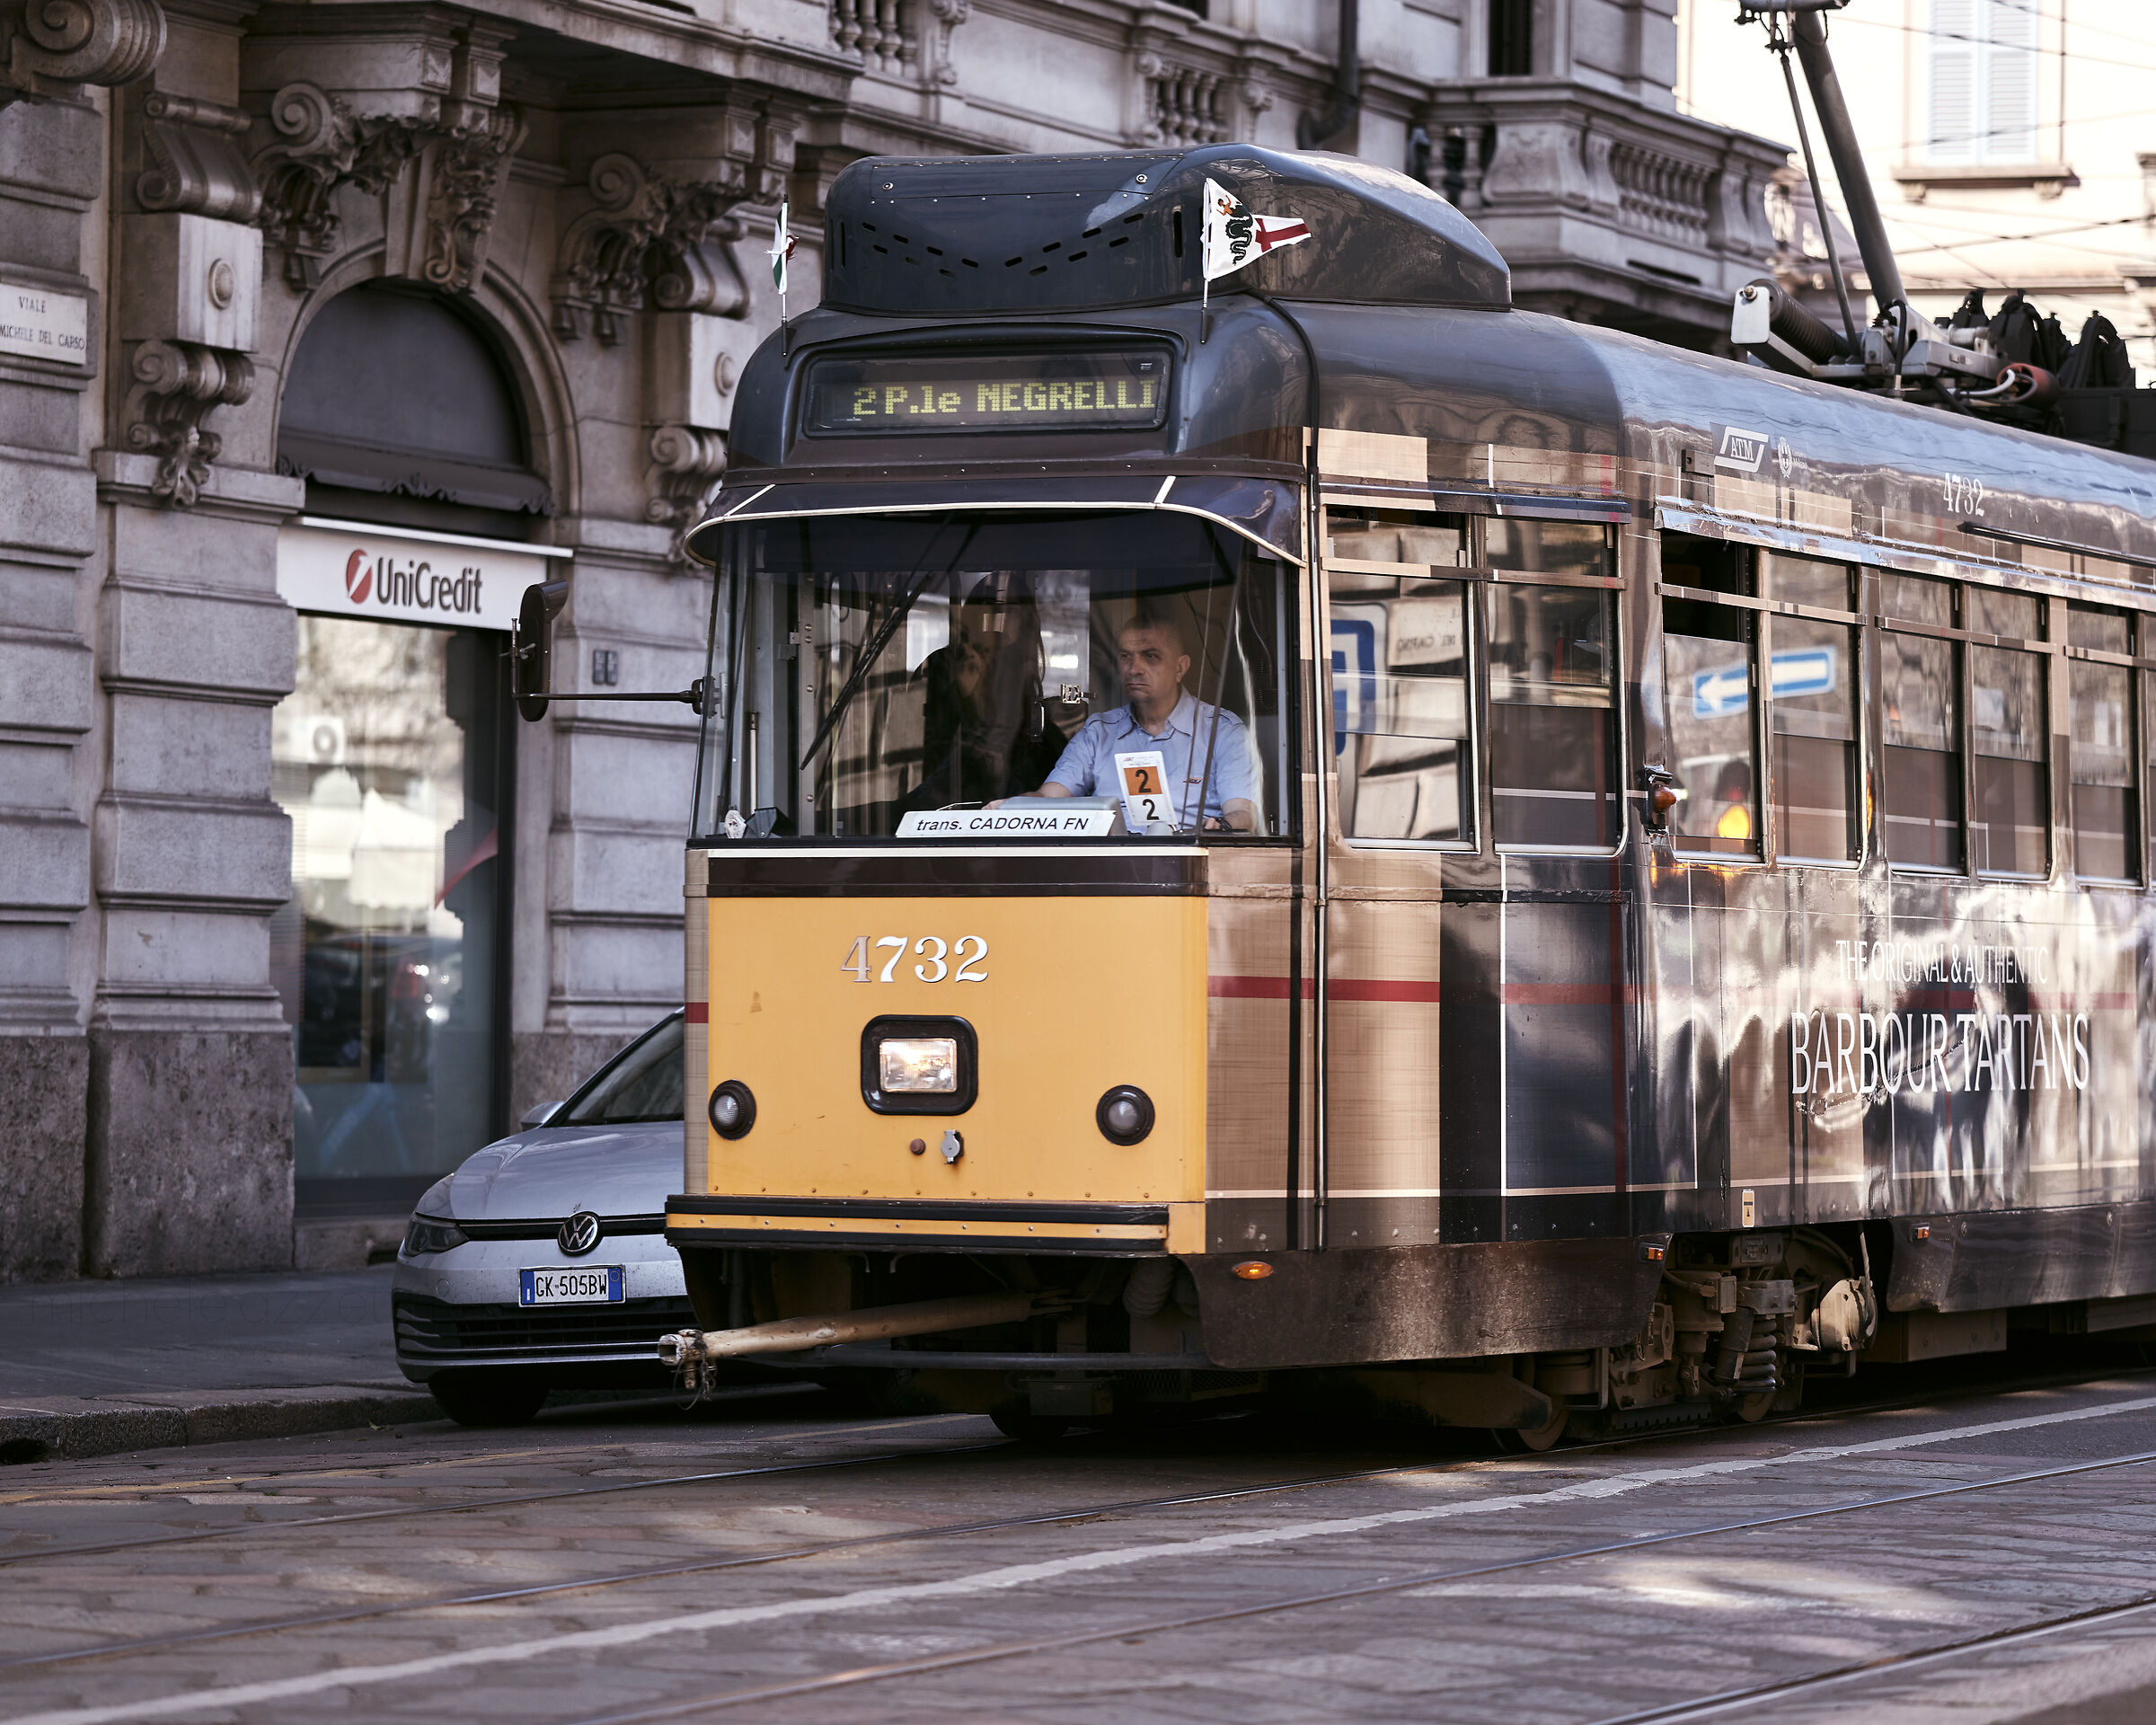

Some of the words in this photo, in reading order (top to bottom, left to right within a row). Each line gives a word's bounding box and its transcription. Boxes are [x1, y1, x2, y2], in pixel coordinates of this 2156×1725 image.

[19, 296, 46, 314] VIALE
[0, 324, 34, 341] MICHELE
[39, 330, 53, 344] DEL
[58, 333, 85, 350] CARSO
[853, 387, 876, 415] 2
[885, 385, 961, 414] P.le
[976, 379, 1156, 412] NEGRELLI
[1730, 437, 1754, 462] ATM
[1943, 473, 1984, 517] 4732
[377, 557, 483, 615] UniCredit
[1135, 769, 1152, 793] 2
[916, 819, 963, 831] trans.
[969, 817, 1057, 830] CADORNA
[1063, 818, 1090, 830] FN
[1142, 799, 1159, 820] 2
[840, 935, 988, 983] 4732
[1835, 940, 1869, 980] THE
[1871, 941, 1948, 983] ORIGINAL
[1950, 943, 1962, 983] &
[1964, 944, 2049, 985] AUTHENTIC
[1790, 1012, 1952, 1094] BARBOUR
[1956, 1013, 2090, 1092] TARTANS
